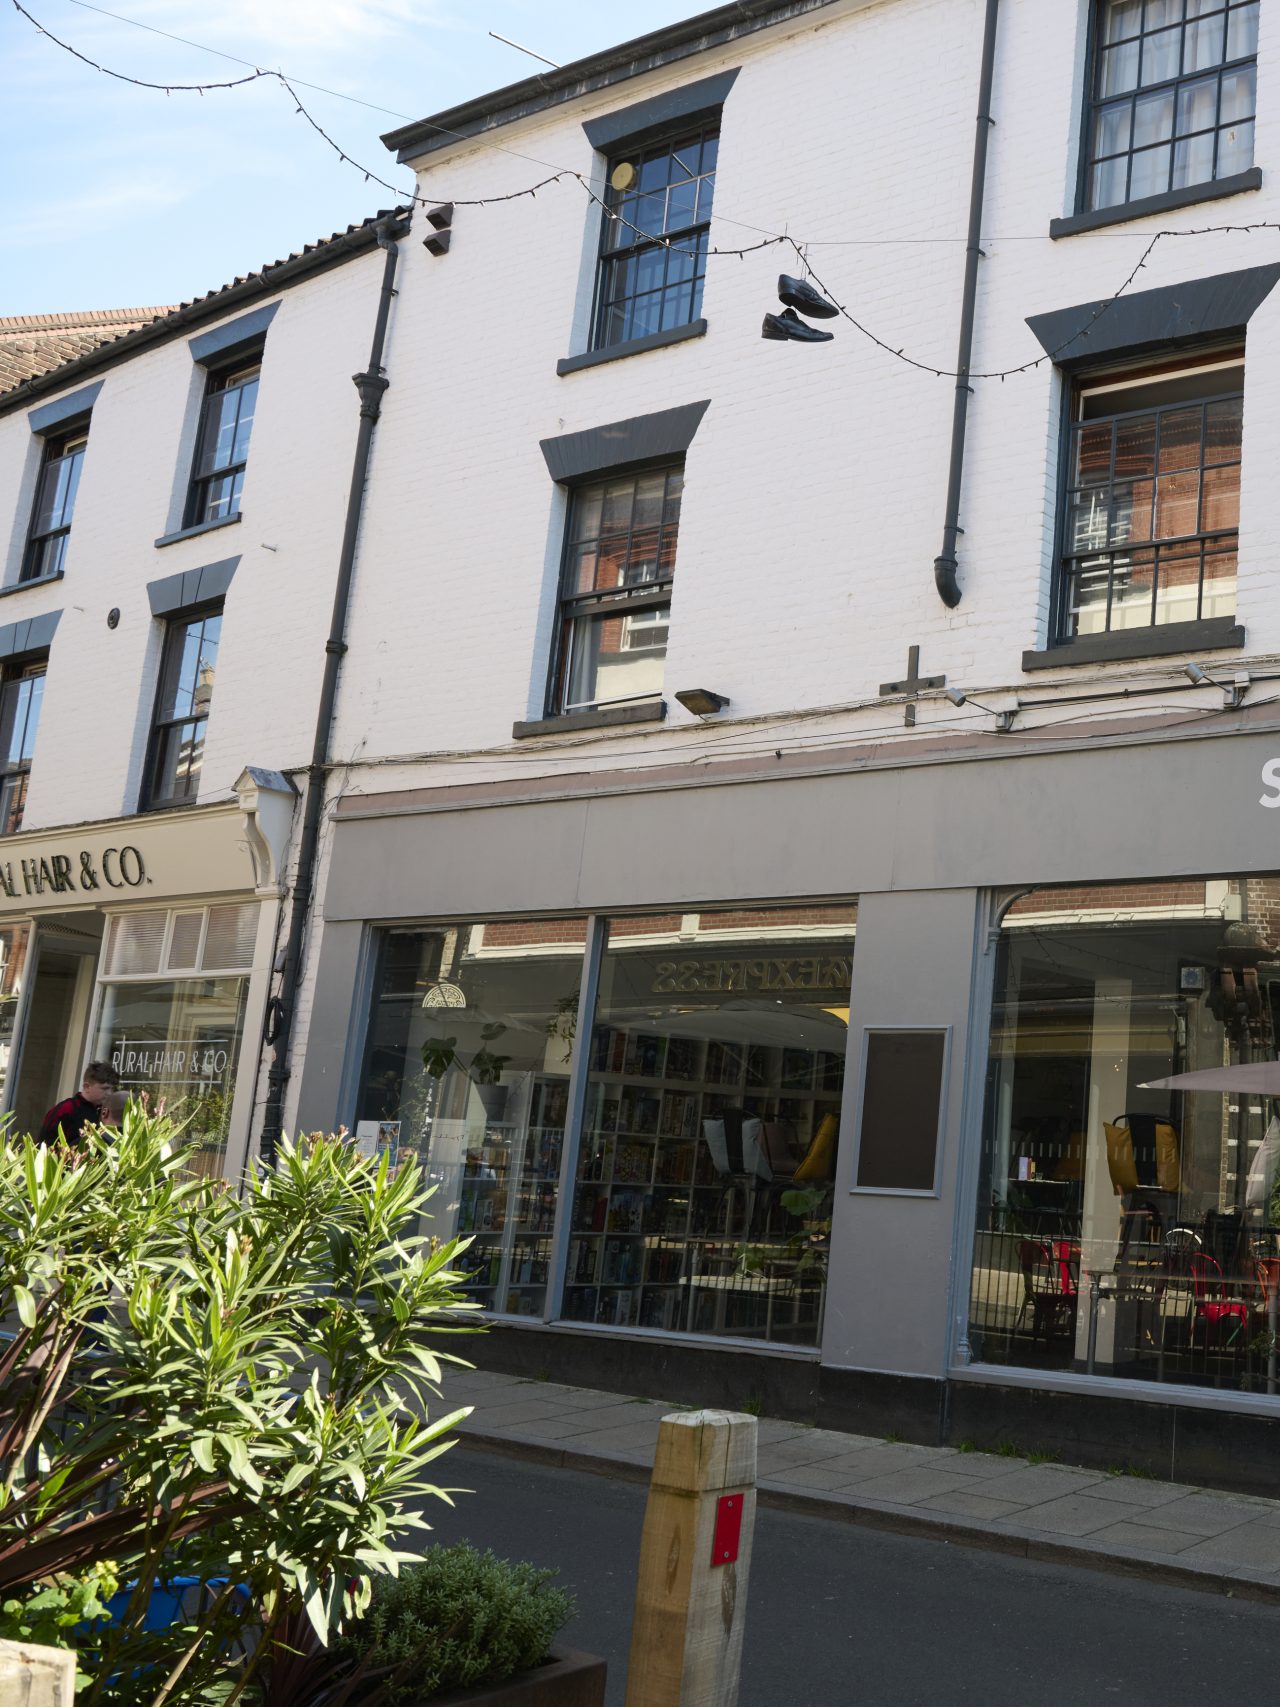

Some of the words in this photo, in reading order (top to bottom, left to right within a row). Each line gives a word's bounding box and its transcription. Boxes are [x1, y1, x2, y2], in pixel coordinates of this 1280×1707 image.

[21, 855, 75, 894] HAIR
[80, 851, 99, 891] &
[102, 846, 152, 888] CO.
[112, 1046, 149, 1075] RURAL
[153, 1050, 185, 1073] HAIR
[189, 1050, 199, 1073] &
